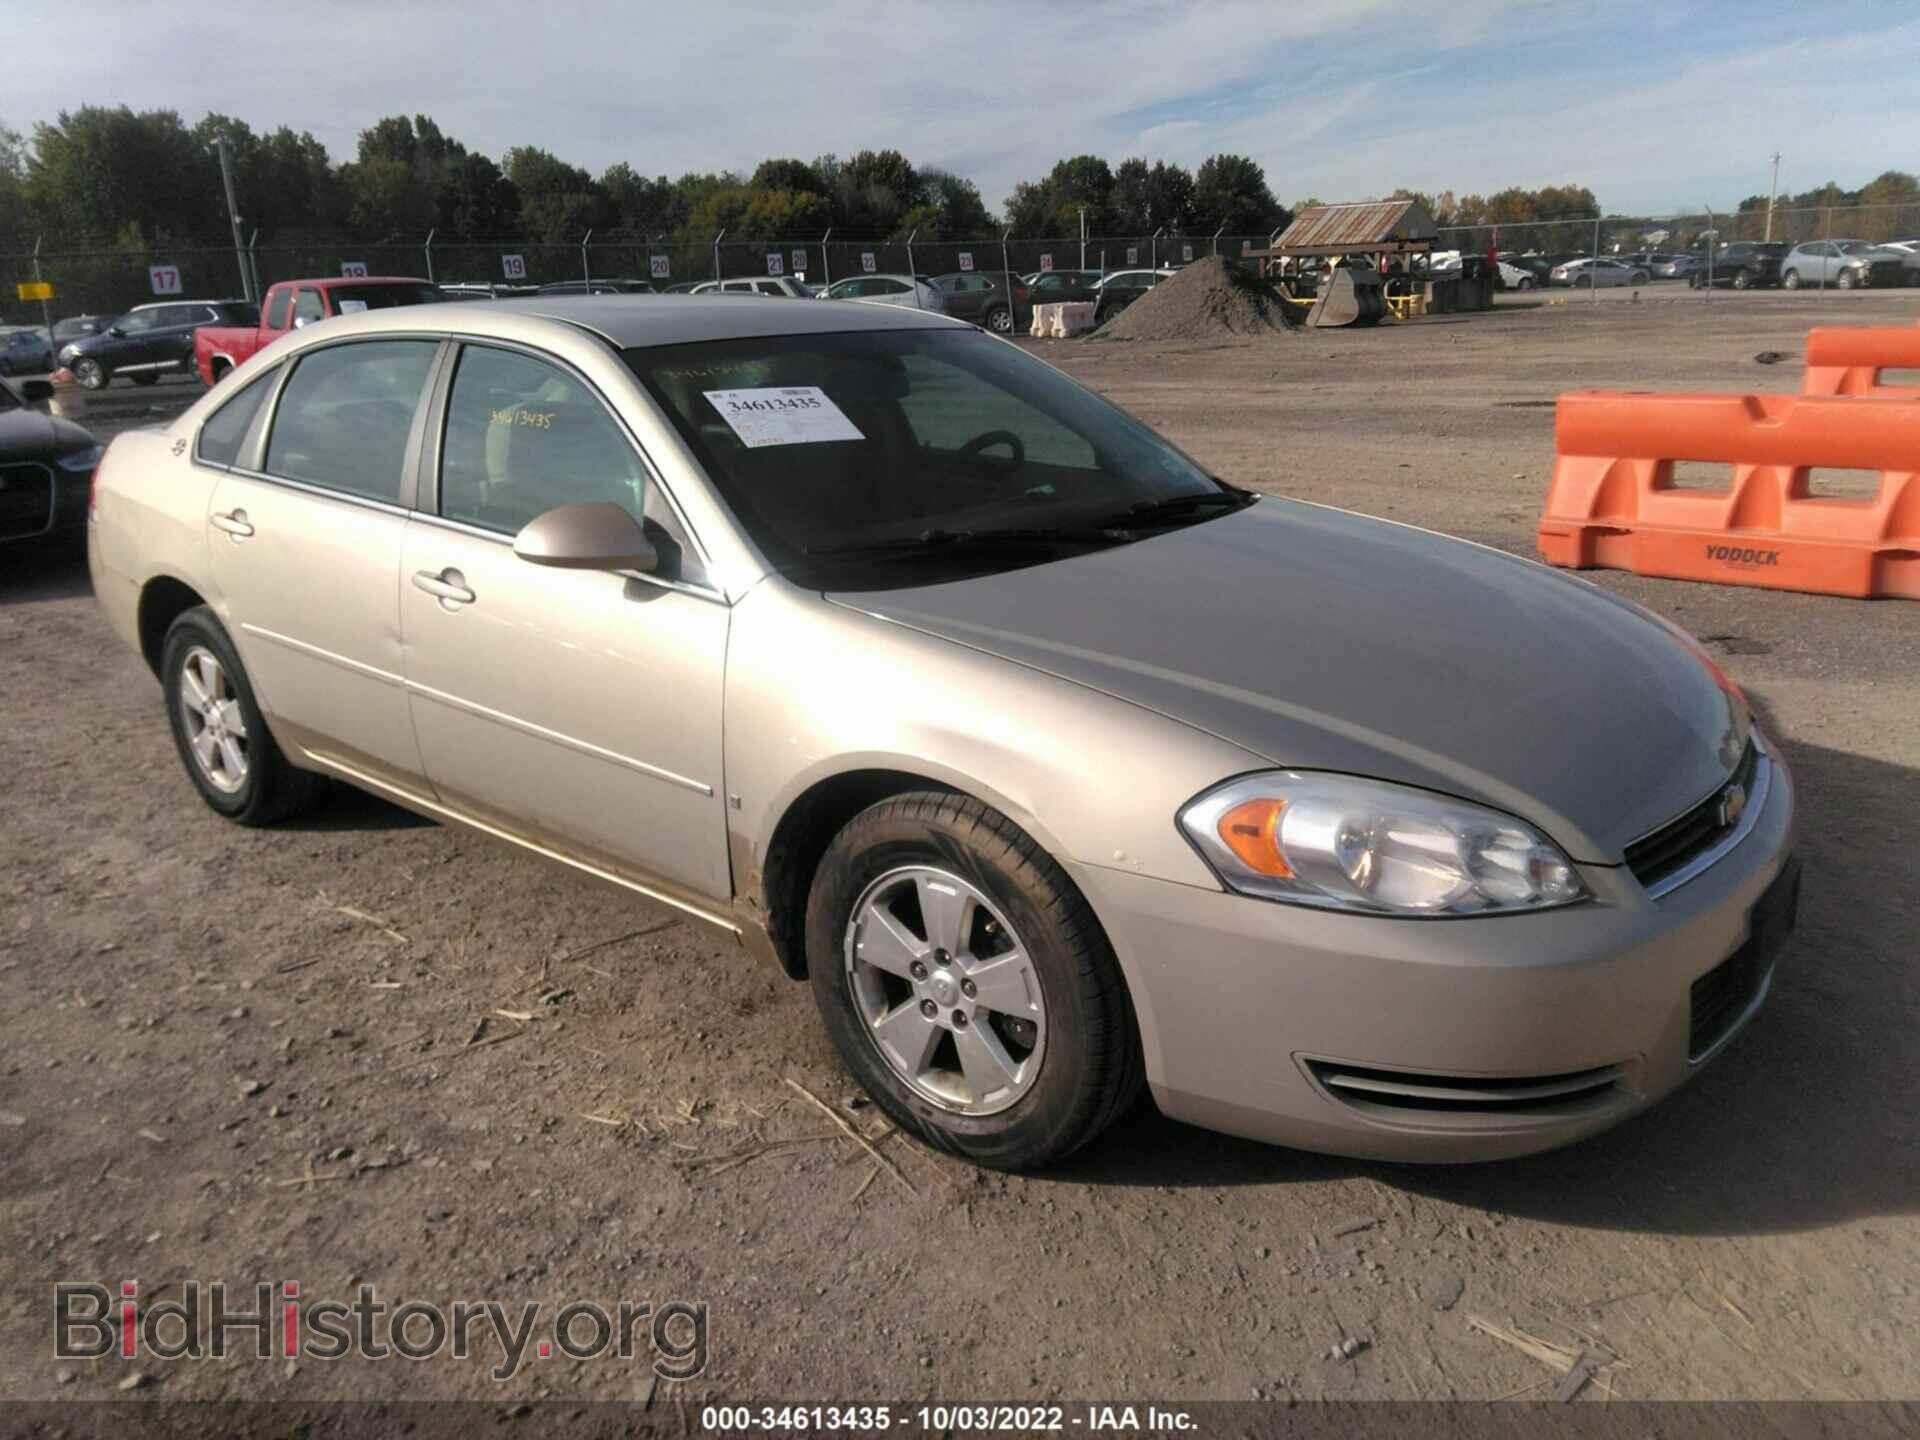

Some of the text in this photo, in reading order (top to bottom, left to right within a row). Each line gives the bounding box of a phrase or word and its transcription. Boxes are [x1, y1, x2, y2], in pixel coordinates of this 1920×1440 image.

[504, 258, 522, 274] 19
[652, 260, 668, 273] 20
[770, 257, 782, 271] 21
[863, 256, 874, 269] 22
[960, 256, 972, 267] 23
[154, 271, 177, 289] 17
[727, 397, 822, 413] 34613435
[1706, 544, 1780, 566] YODOCK
